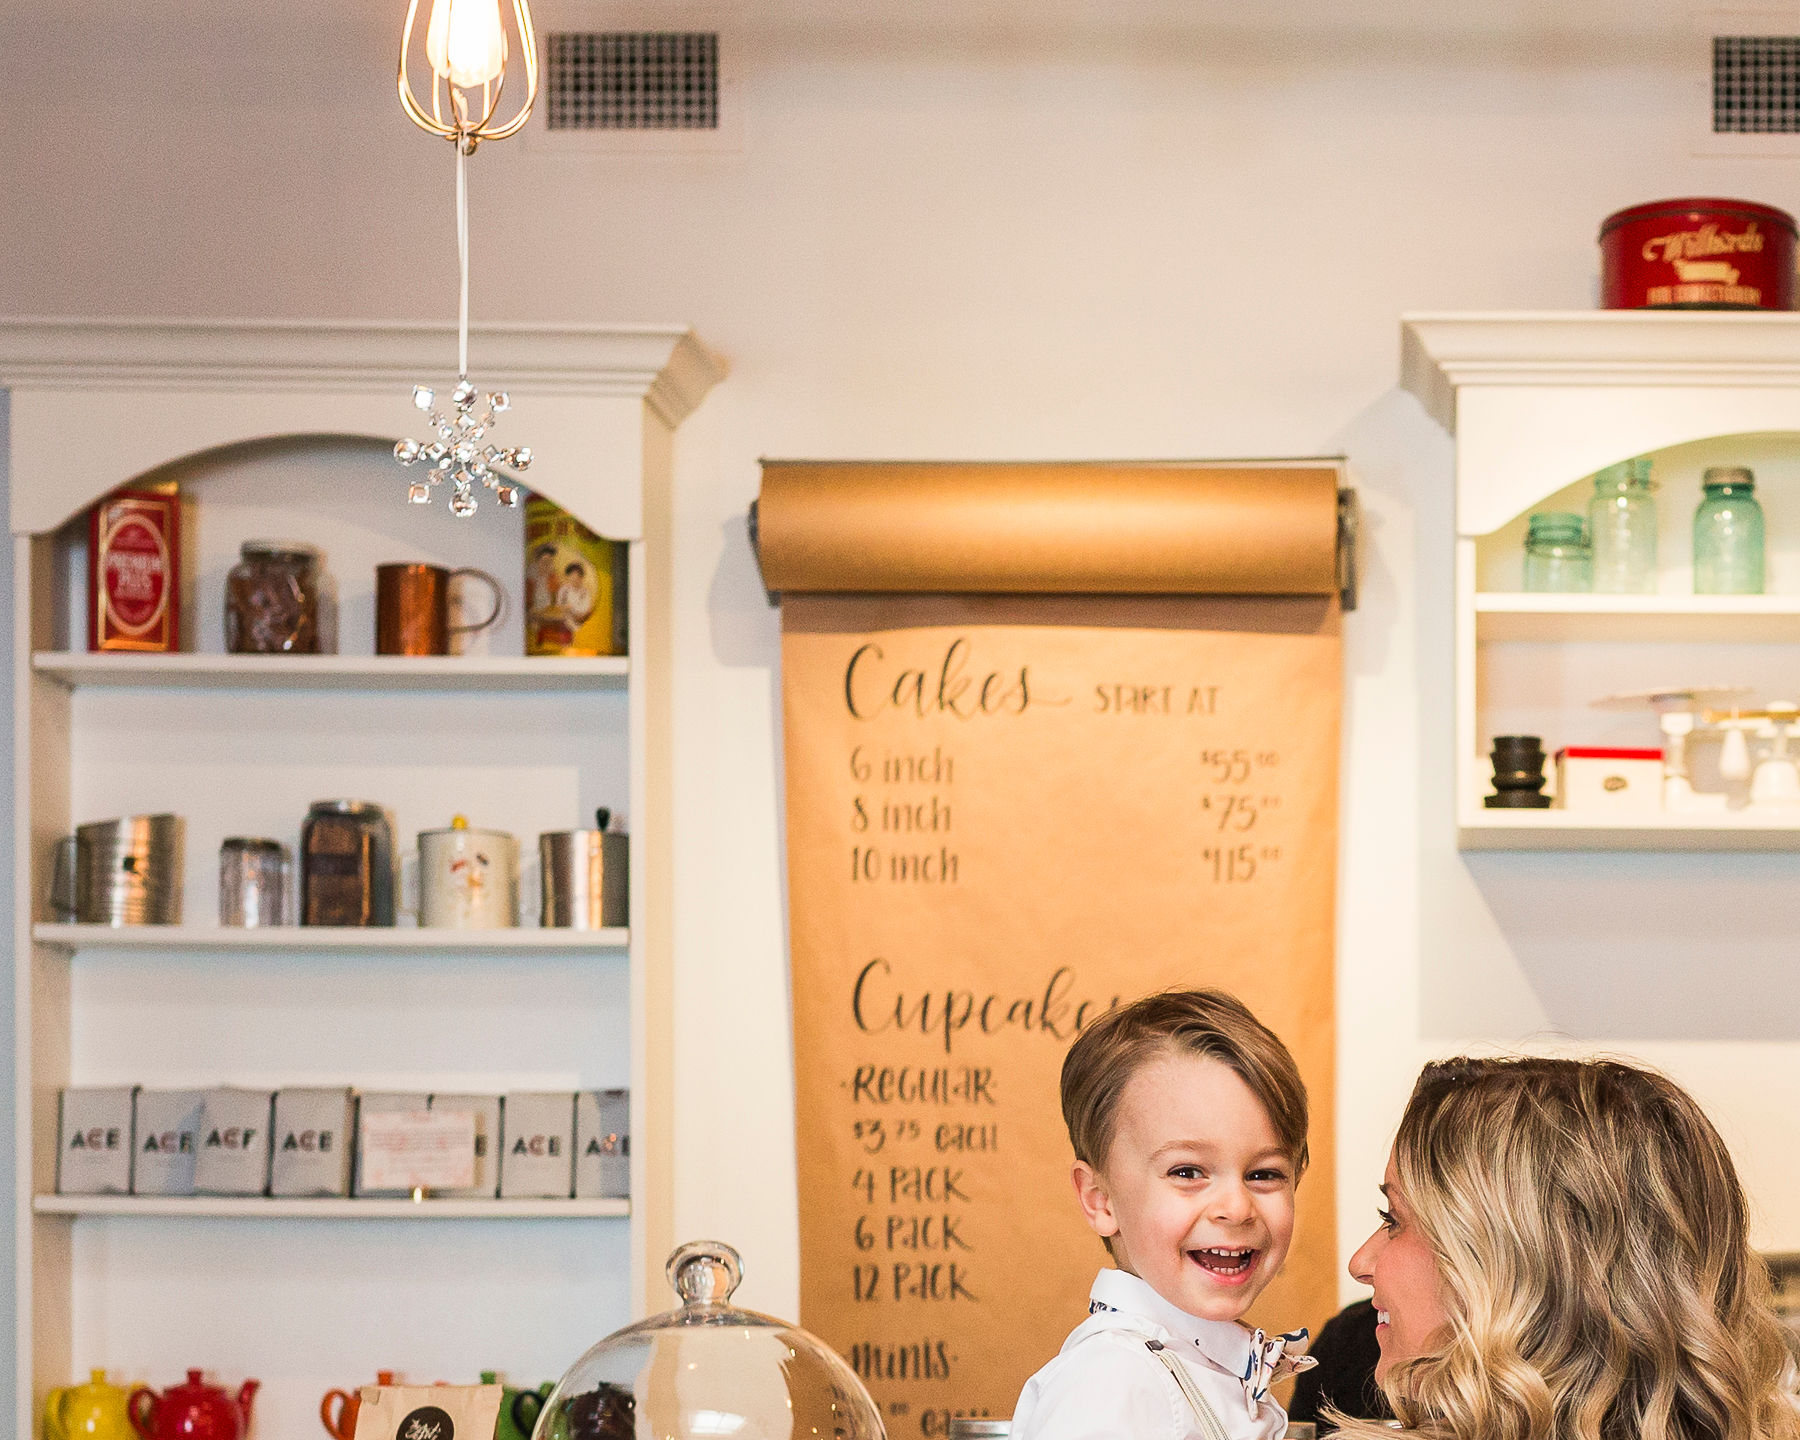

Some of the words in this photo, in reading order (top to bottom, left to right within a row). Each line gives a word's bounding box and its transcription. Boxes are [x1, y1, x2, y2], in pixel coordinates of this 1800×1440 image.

[845, 637, 1072, 721] Cakes
[1093, 684, 1173, 714] START
[1187, 685, 1224, 714] AT
[851, 745, 871, 783] 6
[883, 747, 954, 784] inch
[853, 797, 868, 832] 8
[883, 796, 952, 832] inch
[852, 846, 881, 882] 10
[890, 846, 959, 882] inch
[853, 957, 1120, 1053] Cupcake
[70, 1127, 120, 1150] ACE
[282, 1129, 333, 1152] ACE
[512, 1134, 561, 1157] ACE
[853, 1166, 874, 1204] 4
[855, 1215, 874, 1250] 6
[853, 1263, 880, 1302] 12
